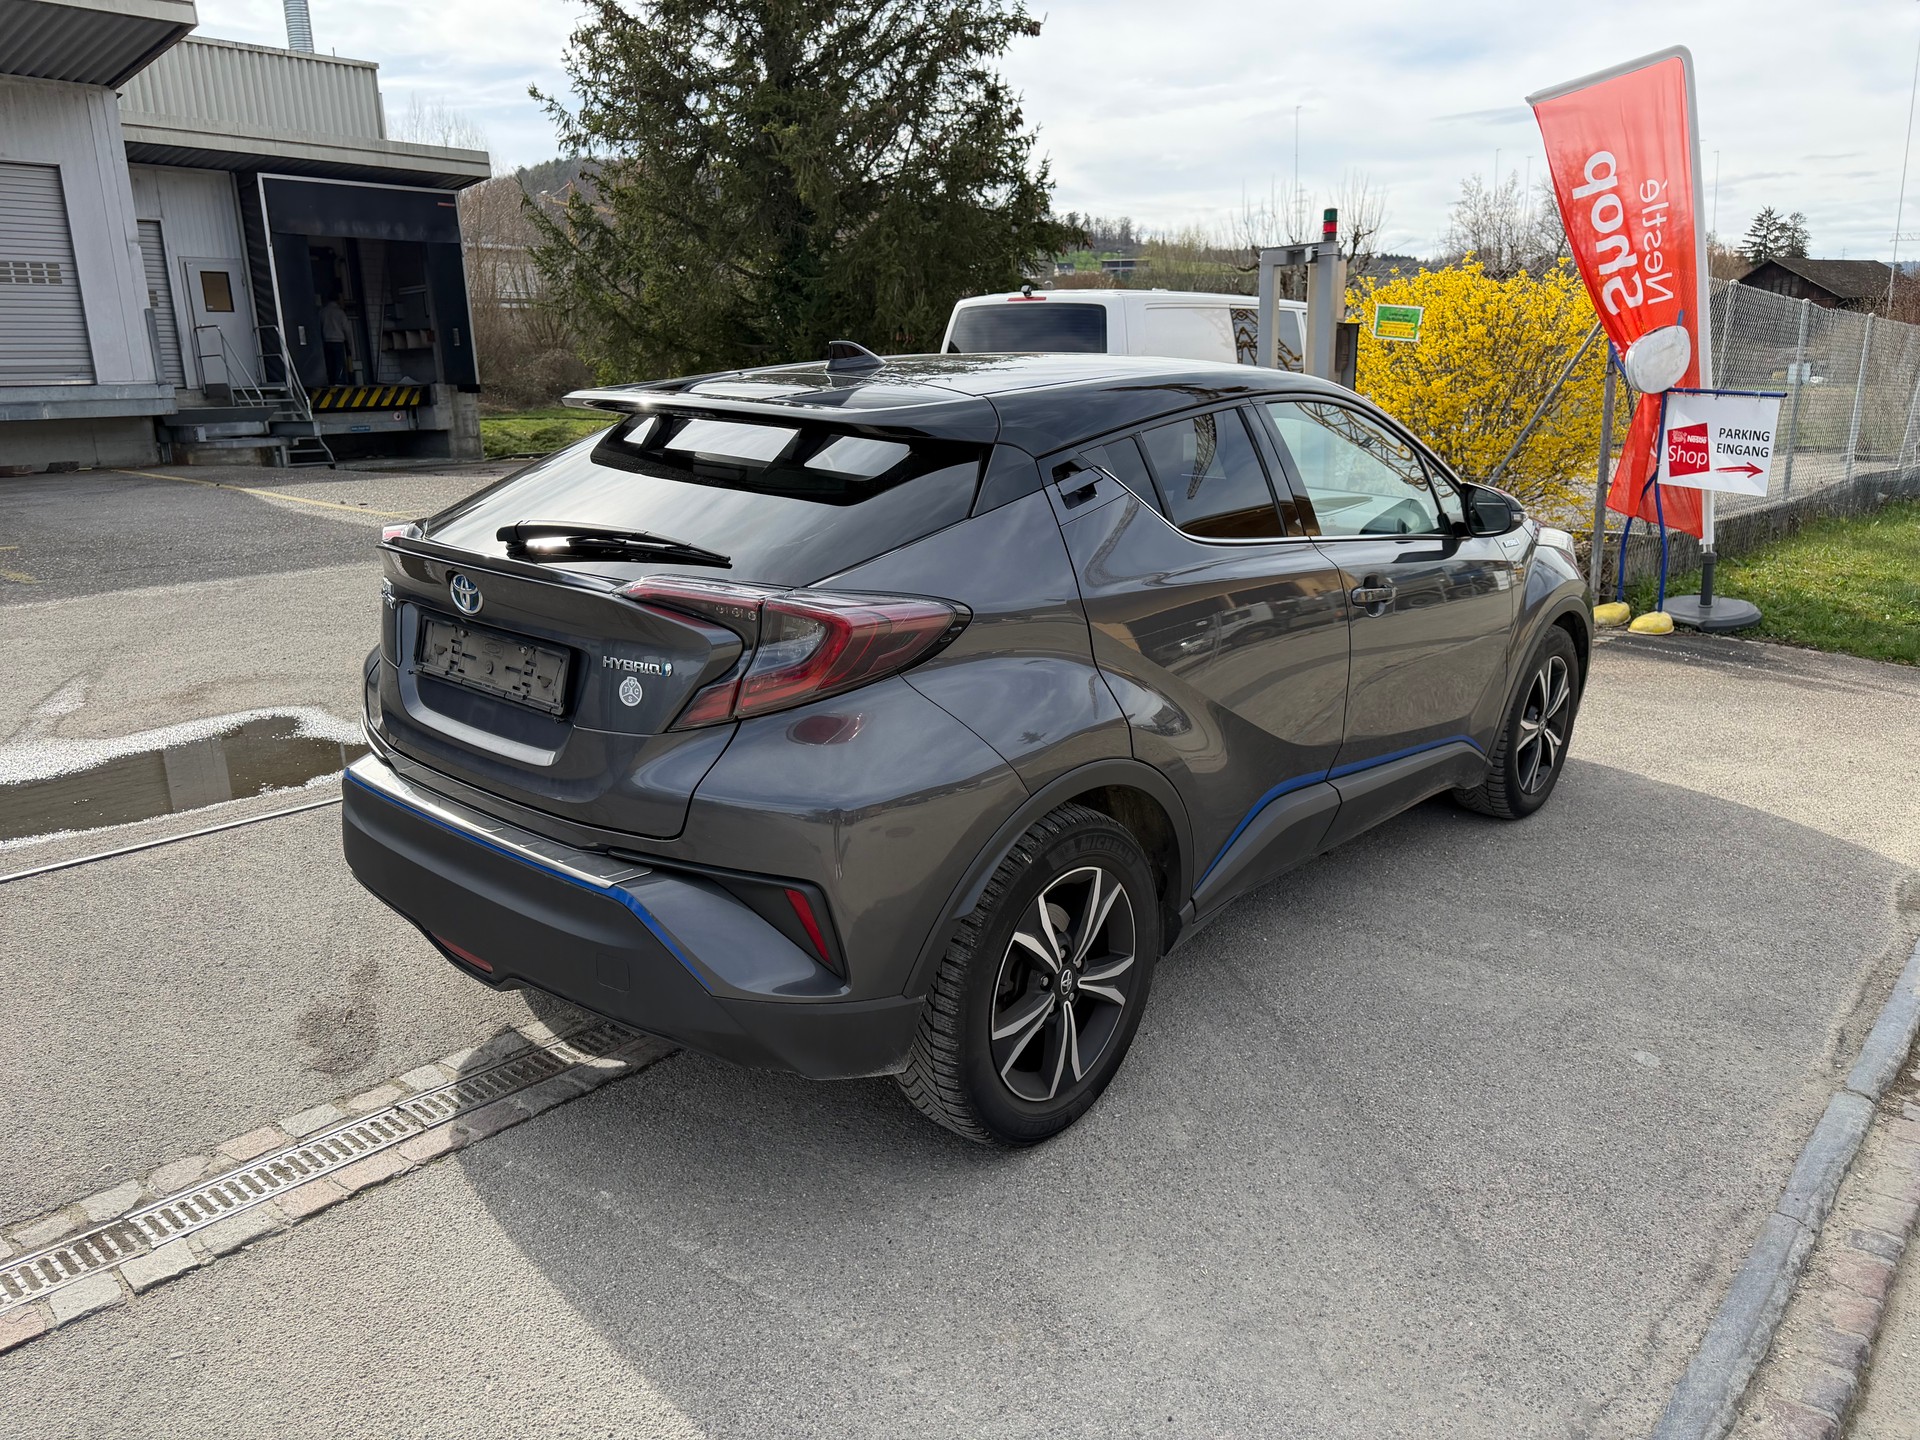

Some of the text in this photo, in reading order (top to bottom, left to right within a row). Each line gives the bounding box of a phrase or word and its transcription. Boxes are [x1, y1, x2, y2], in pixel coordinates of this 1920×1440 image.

[1719, 428, 1770, 442] PARKING
[1668, 445, 1708, 469] Shop
[1716, 443, 1769, 458] EINGANG
[602, 656, 663, 675] HYBRID
